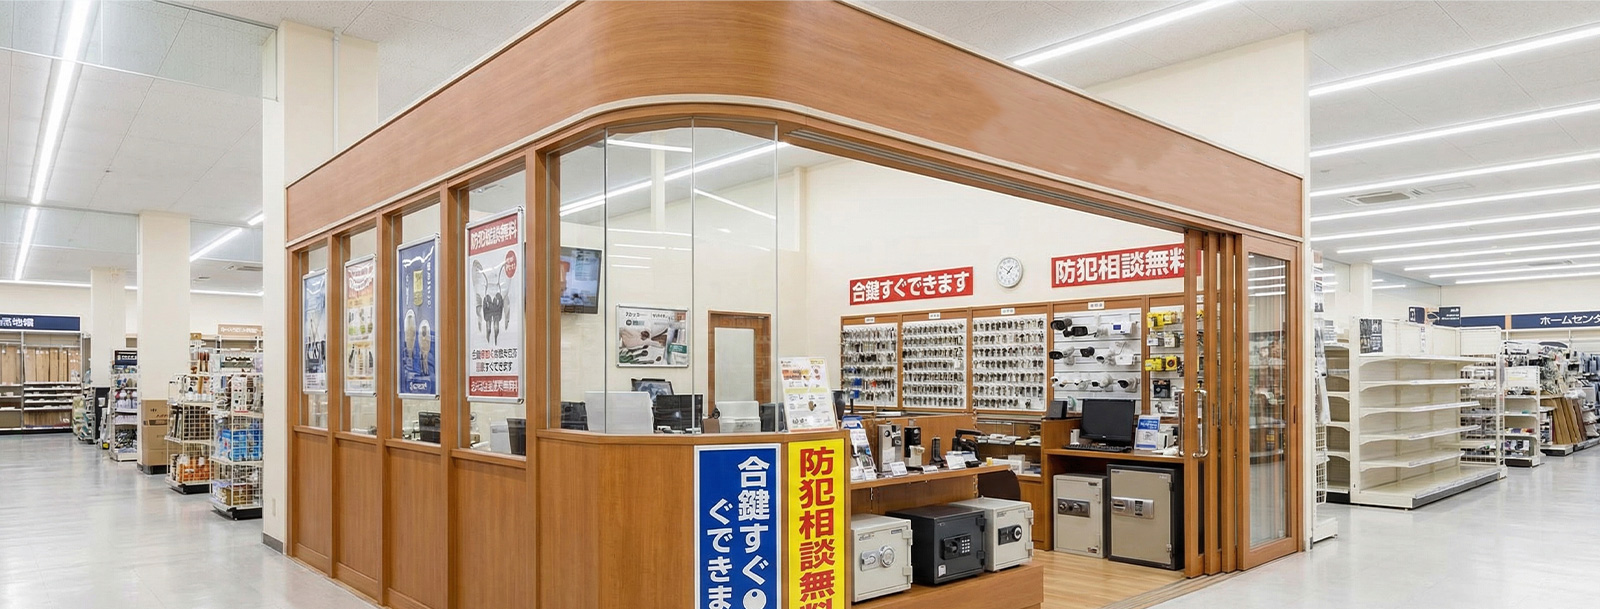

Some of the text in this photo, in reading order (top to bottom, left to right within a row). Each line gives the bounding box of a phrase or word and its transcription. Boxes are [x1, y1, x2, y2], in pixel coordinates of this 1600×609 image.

[852, 271, 970, 302] 合鍵すぐできます
[707, 498, 734, 609] ぐできま
[737, 456, 770, 586] 合鍵すぐ
